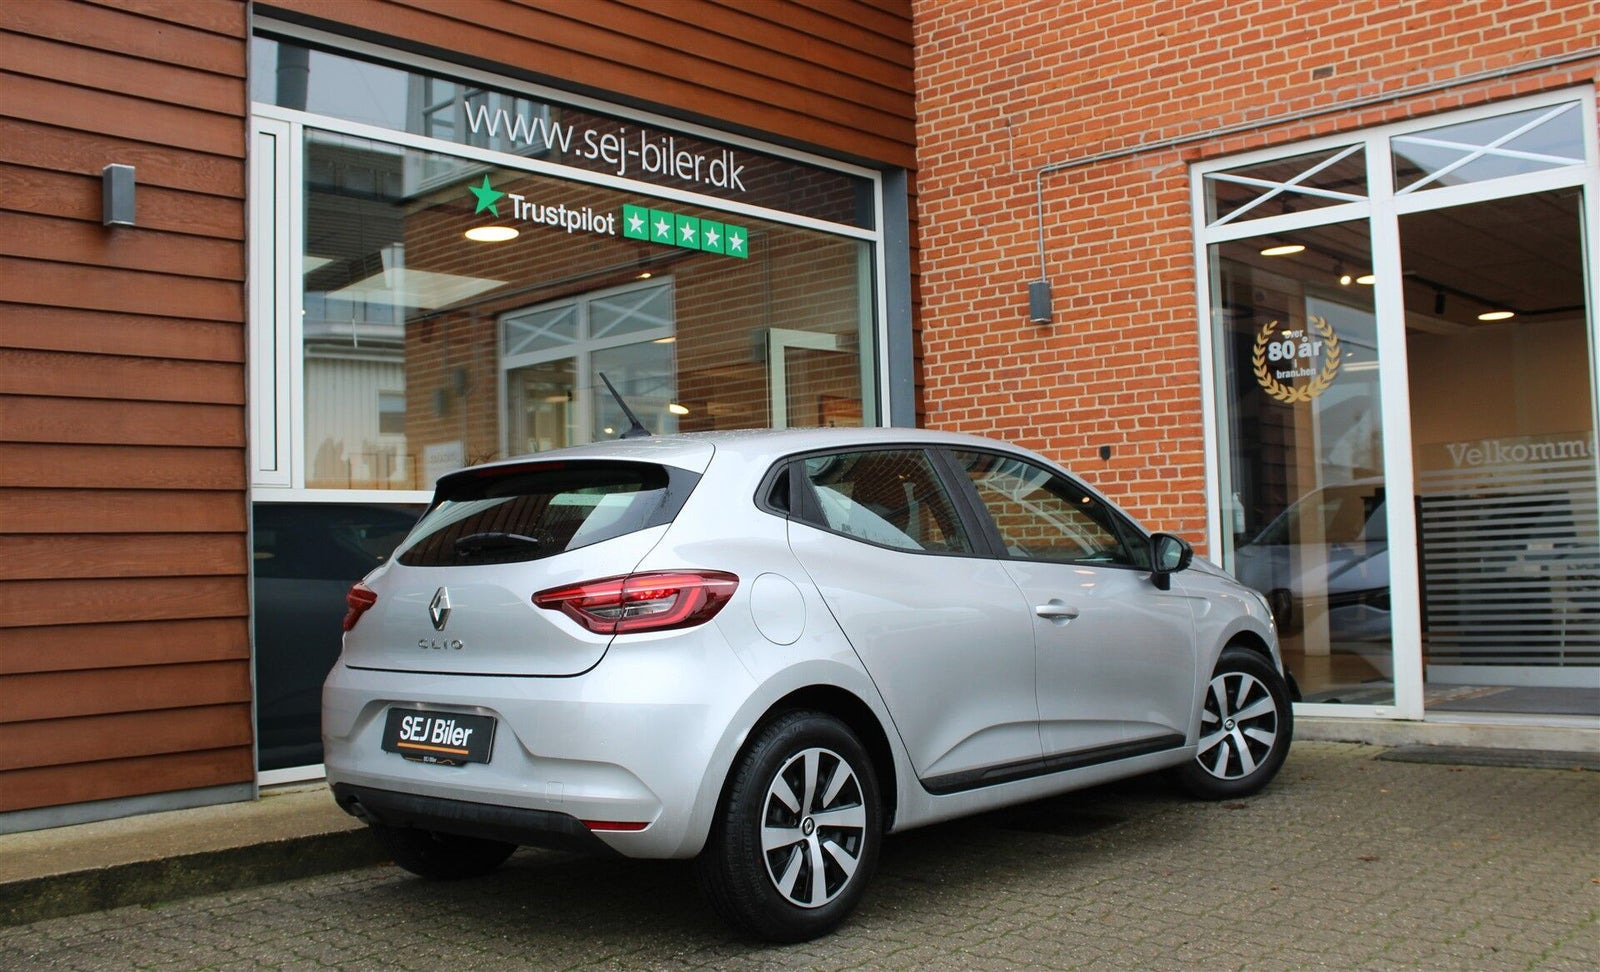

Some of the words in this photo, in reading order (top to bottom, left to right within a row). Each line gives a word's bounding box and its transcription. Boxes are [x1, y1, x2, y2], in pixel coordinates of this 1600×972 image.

[464, 100, 746, 192] www.sej-biler.dk
[508, 193, 616, 236] Trustpilot
[1268, 341, 1296, 361] 80
[1299, 336, 1322, 357] år
[418, 638, 464, 650] CLIO
[400, 715, 432, 742] SEJ
[431, 718, 473, 748] Biler
